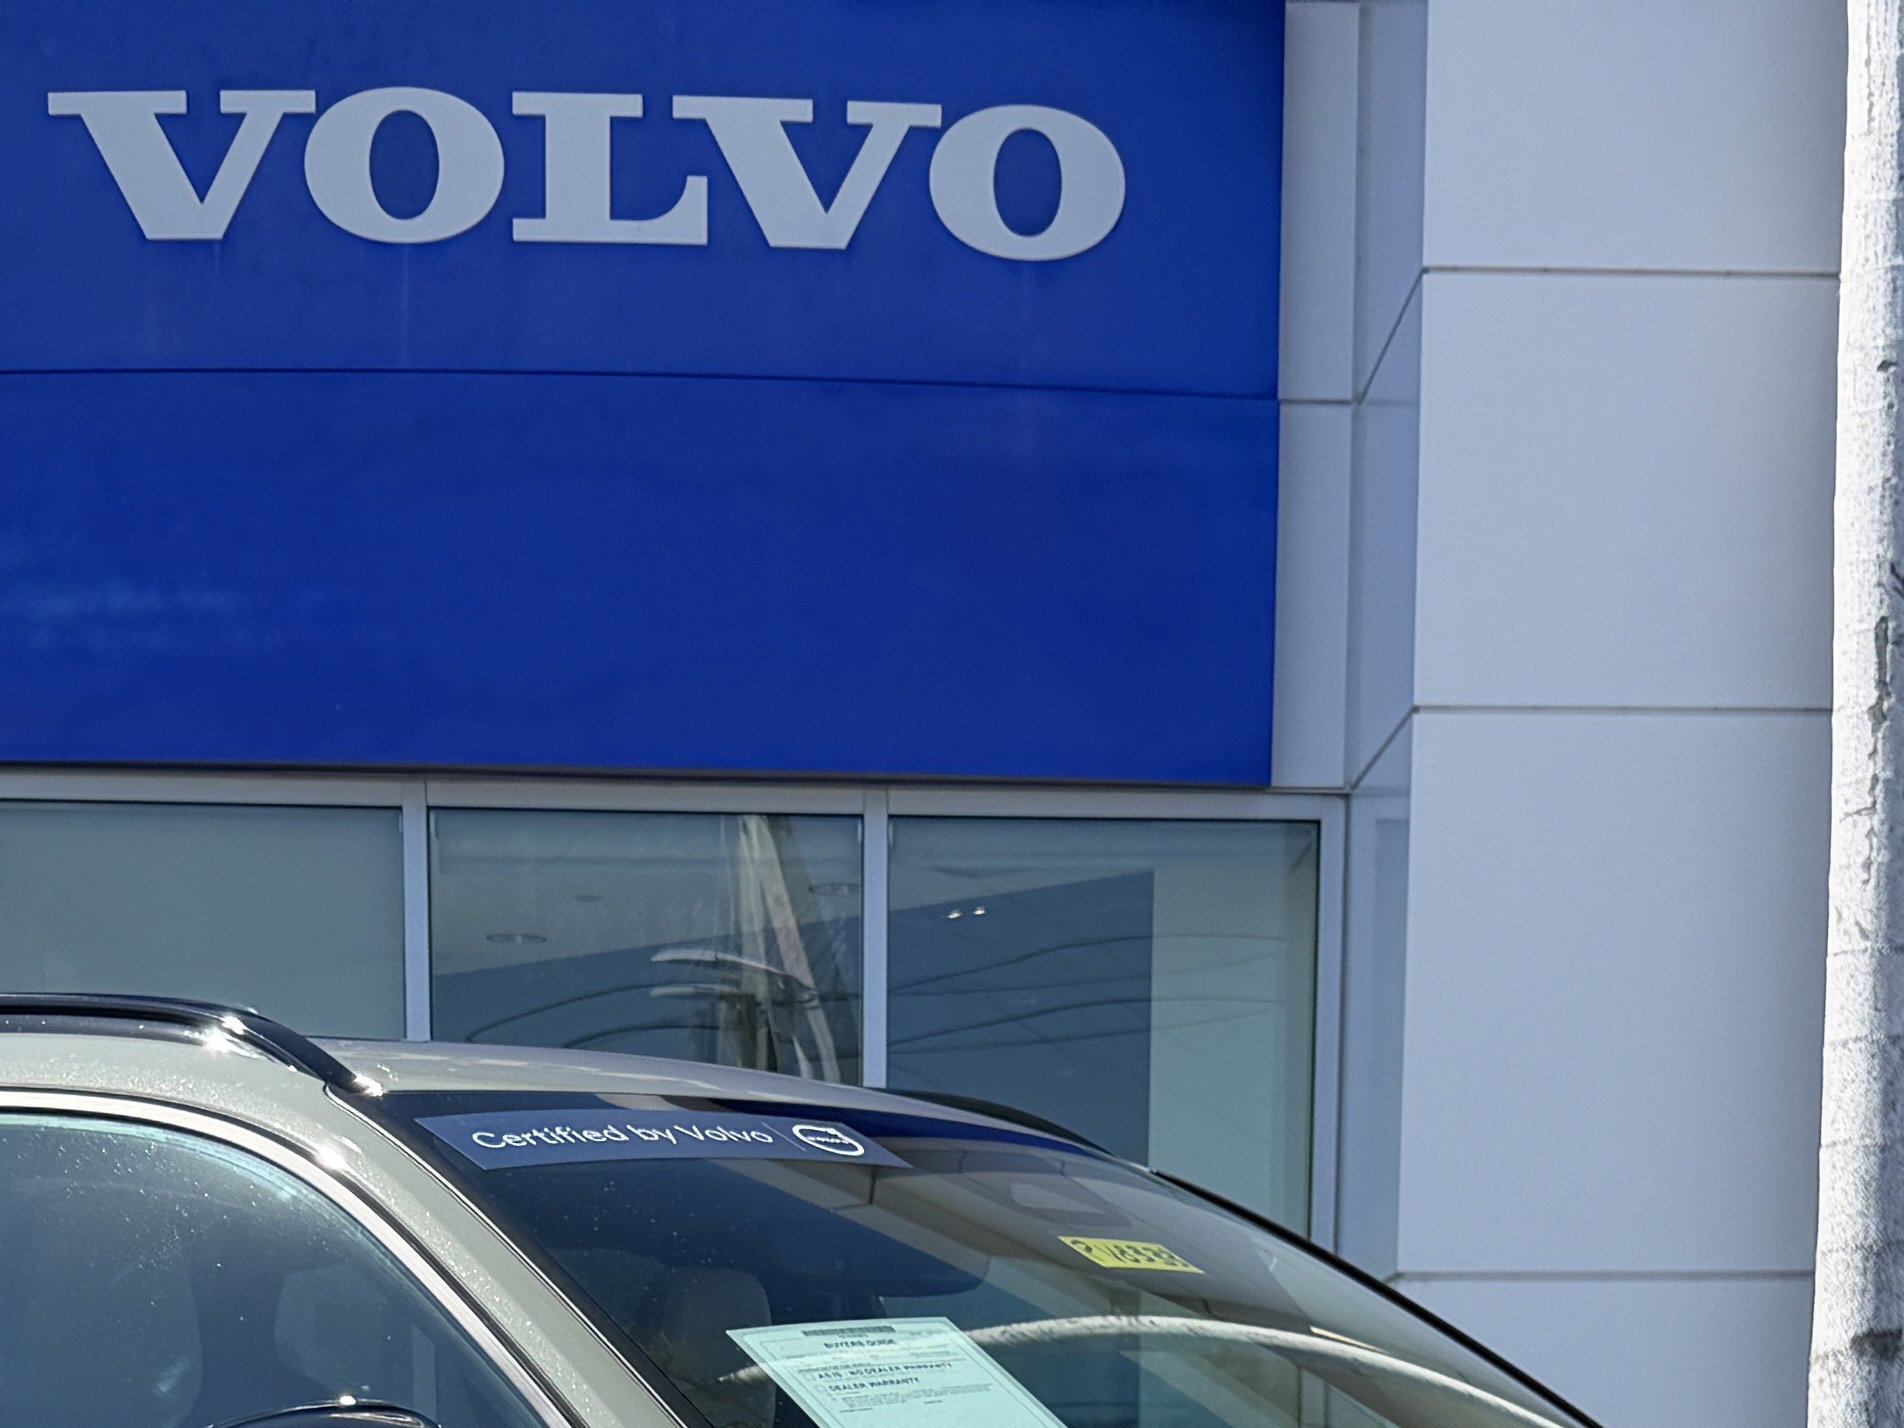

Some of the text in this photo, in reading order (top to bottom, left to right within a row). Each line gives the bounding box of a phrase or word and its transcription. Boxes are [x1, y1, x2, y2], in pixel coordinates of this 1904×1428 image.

[47, 86, 1125, 261] VOLVO
[472, 1125, 773, 1148] Certified by Volvo
